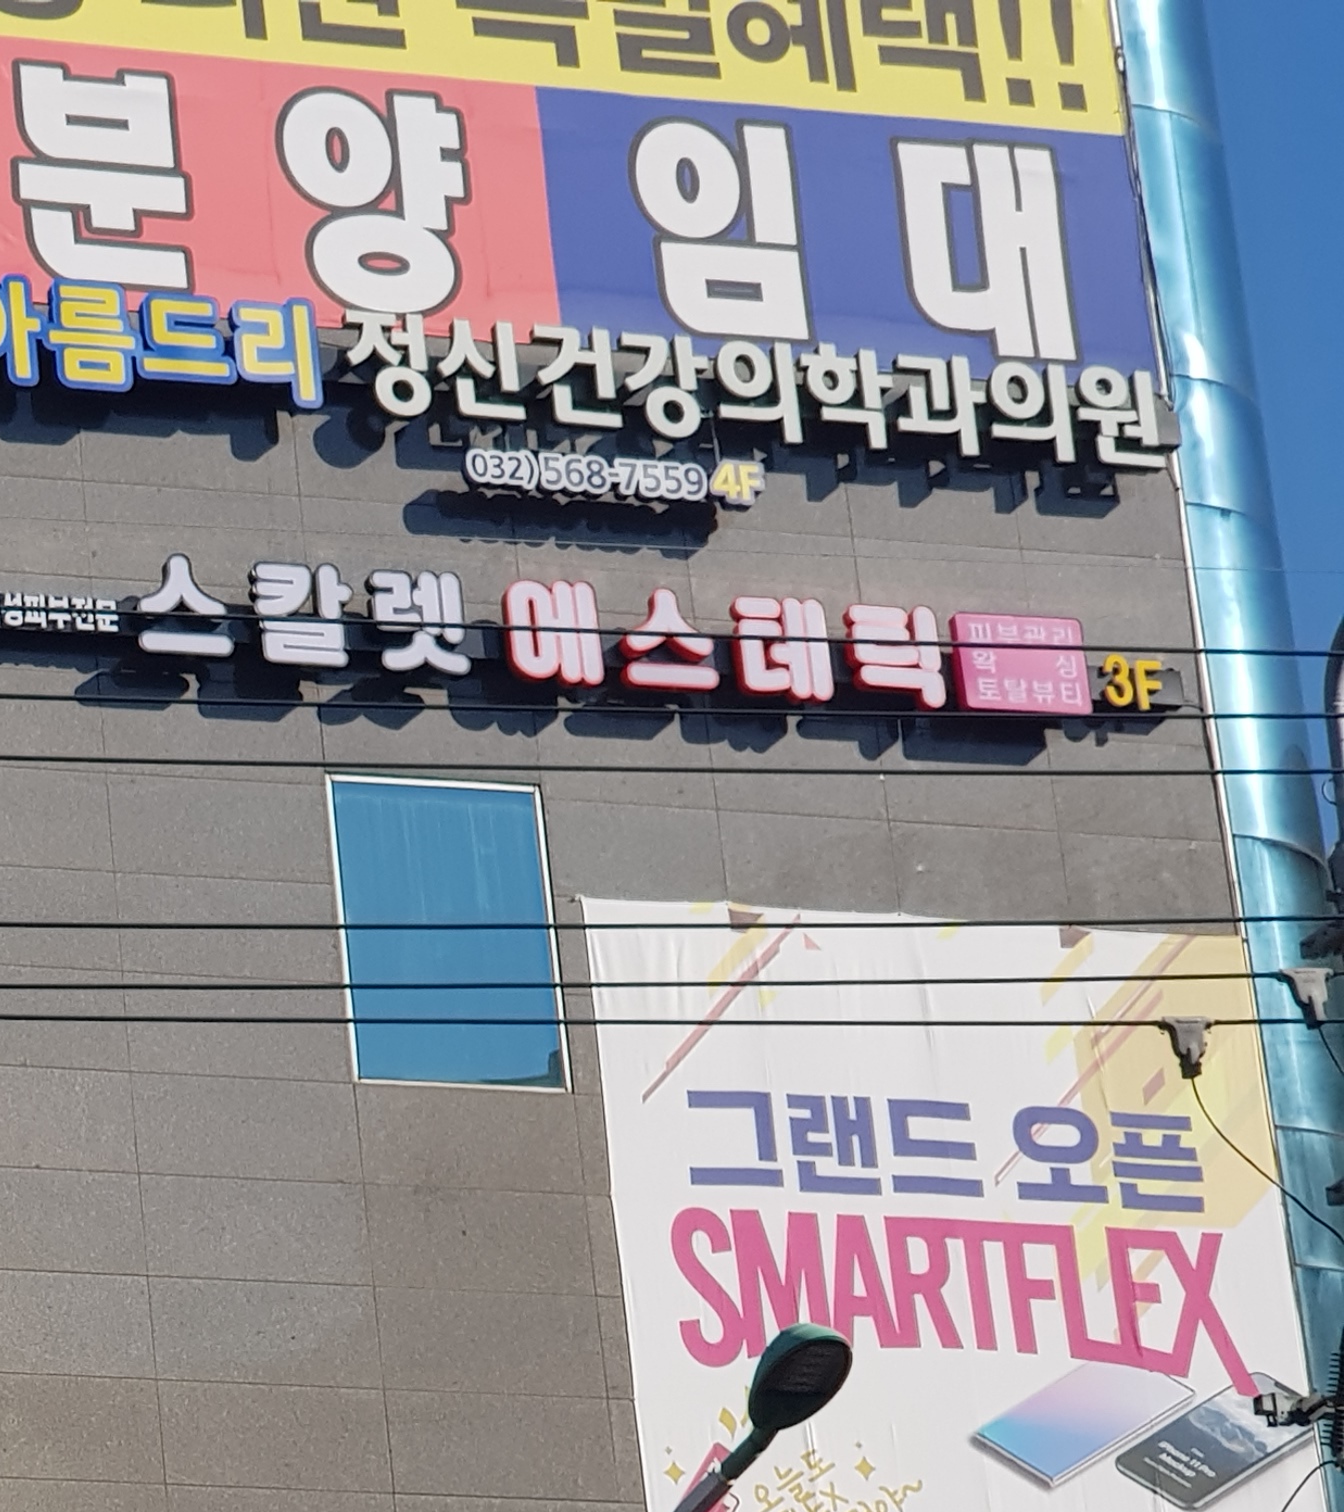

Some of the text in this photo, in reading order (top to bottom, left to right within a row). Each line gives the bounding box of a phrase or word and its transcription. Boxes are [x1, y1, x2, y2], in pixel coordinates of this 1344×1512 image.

[343, 308, 1167, 469] 정신건강의학과의원
[711, 459, 766, 504] 4F
[137, 553, 472, 676] 스칼렛
[1102, 653, 1162, 711] 3F
[687, 1090, 1206, 1213] 그랜드 오픈
[670, 1206, 1260, 1398] SMARTFLEX
